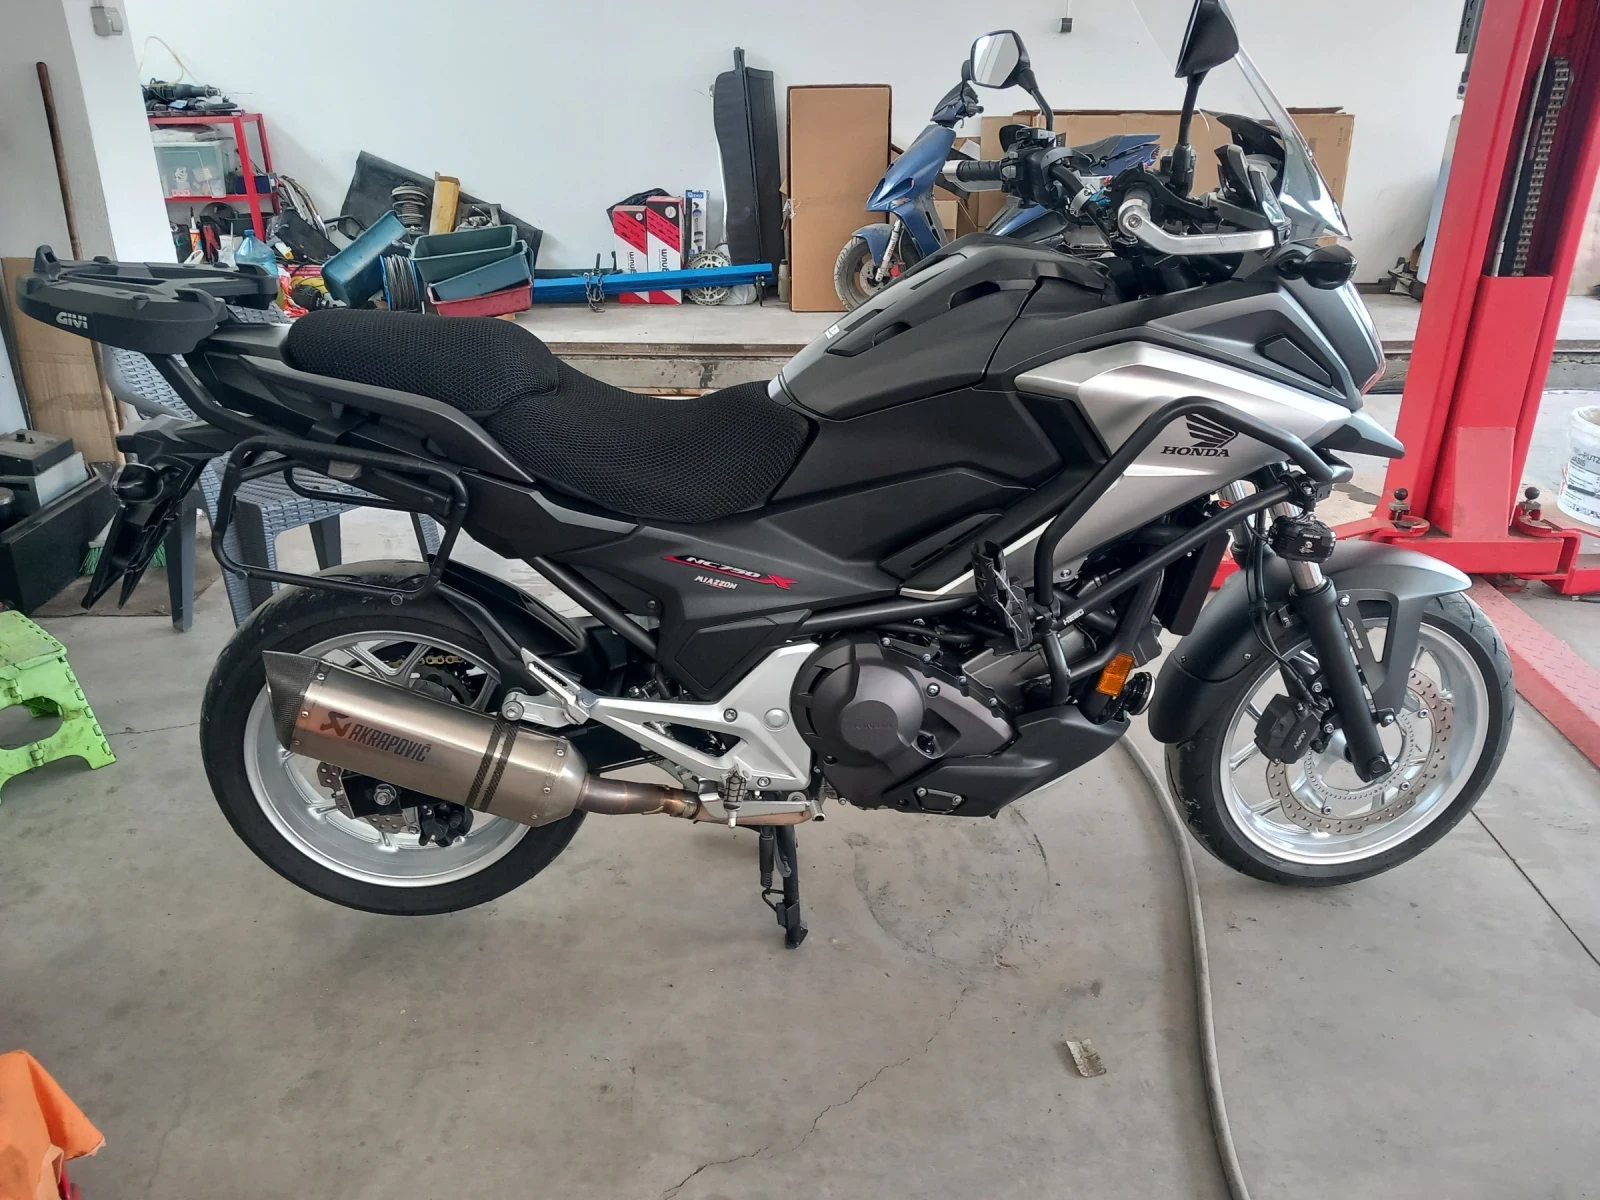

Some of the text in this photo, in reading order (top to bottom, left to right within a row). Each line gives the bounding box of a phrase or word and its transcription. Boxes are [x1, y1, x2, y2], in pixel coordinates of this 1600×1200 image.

[55, 311, 88, 329] GIVI
[1160, 445, 1231, 457] HONDA
[686, 556, 761, 578] NC750
